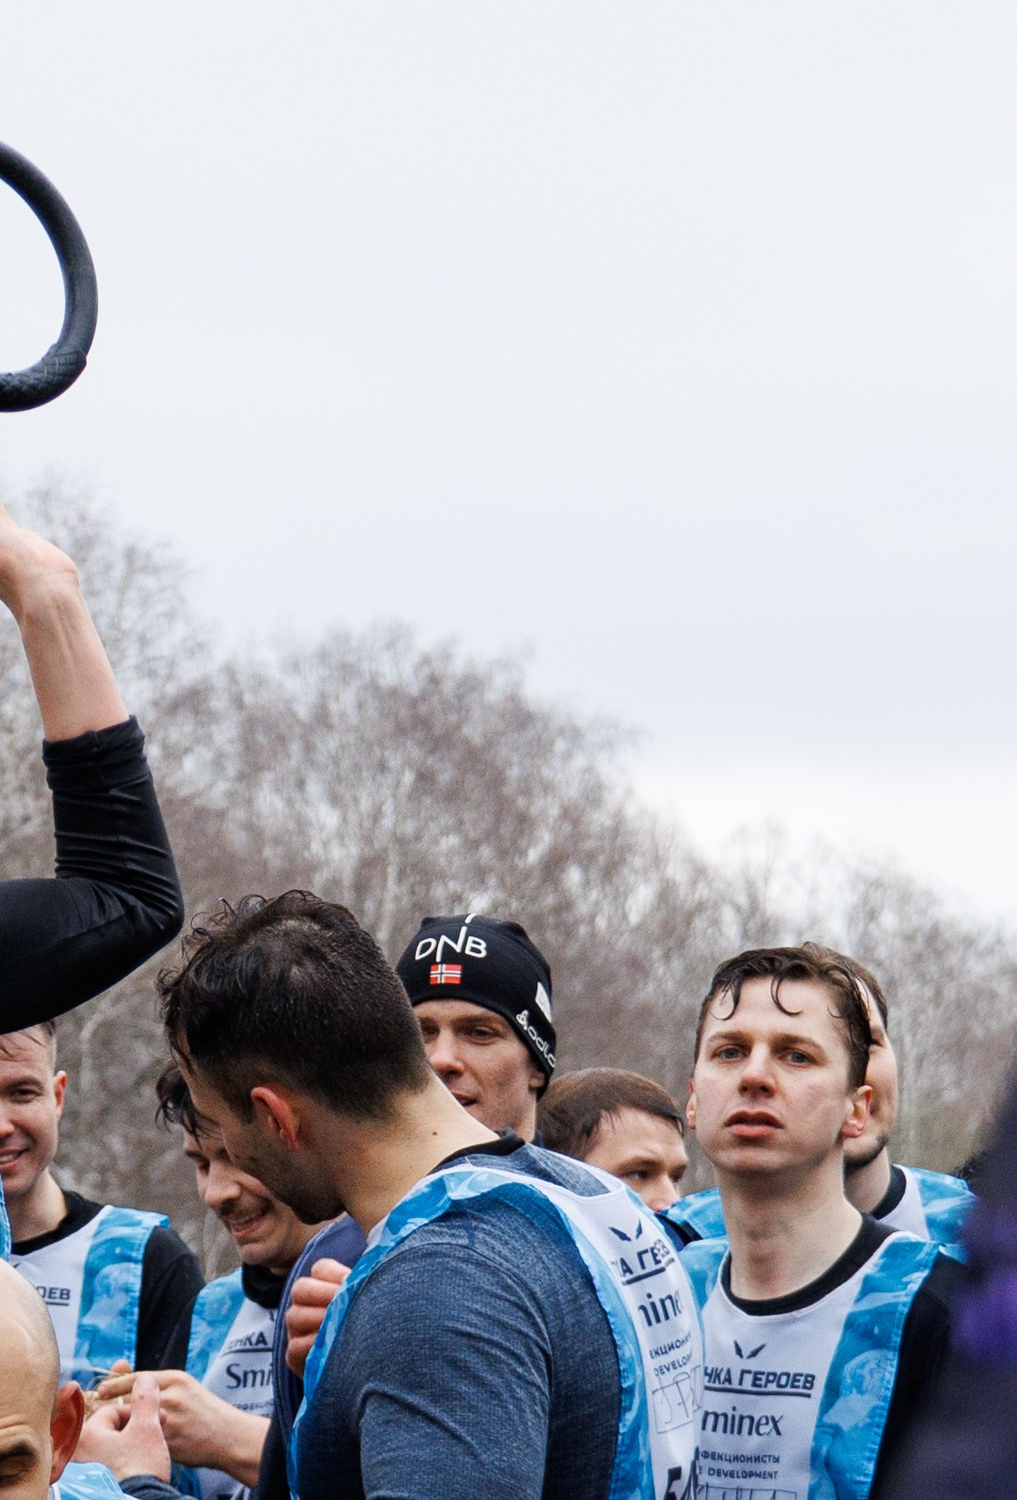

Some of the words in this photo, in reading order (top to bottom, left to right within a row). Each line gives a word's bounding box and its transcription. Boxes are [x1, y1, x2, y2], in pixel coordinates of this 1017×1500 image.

[415, 925, 487, 962] DNB
[36, 1286, 71, 1300] ОЕВ
[225, 1362, 273, 1390] Smi
[704, 1366, 733, 1386] НКА
[738, 1369, 816, 1391] ГЕРОЕВ
[700, 1405, 784, 1437] minex
[700, 1449, 781, 1464] ФЕКЦИОНИСТЫ
[707, 1466, 779, 1480] DEVELOPMENT
